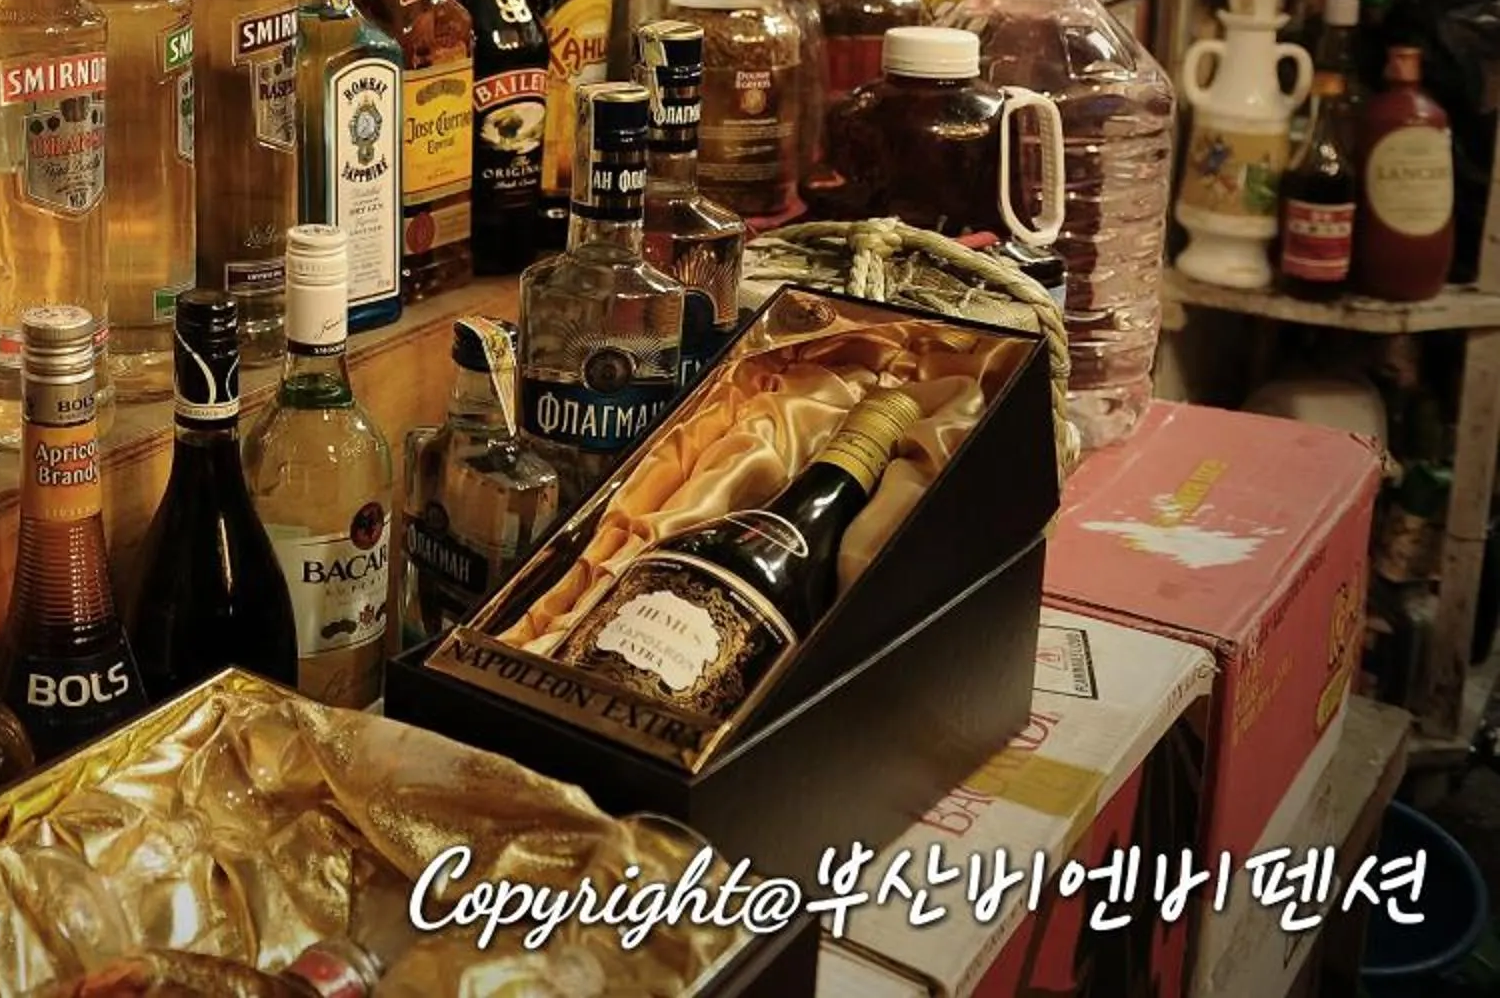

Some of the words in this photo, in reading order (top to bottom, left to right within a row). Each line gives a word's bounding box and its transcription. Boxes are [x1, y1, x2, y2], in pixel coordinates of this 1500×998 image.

[7, 56, 106, 96] SMIRNO
[343, 77, 389, 102] BOMBAY
[475, 73, 548, 104] BAILE
[406, 114, 434, 145] Jose
[341, 153, 389, 183] SAPPHIRE
[57, 395, 95, 413] BOLS
[536, 389, 666, 444] ФЛАГМА
[303, 544, 387, 583] BACAR
[27, 661, 130, 708] BOLS
[451, 642, 592, 708] NAPOLEON
